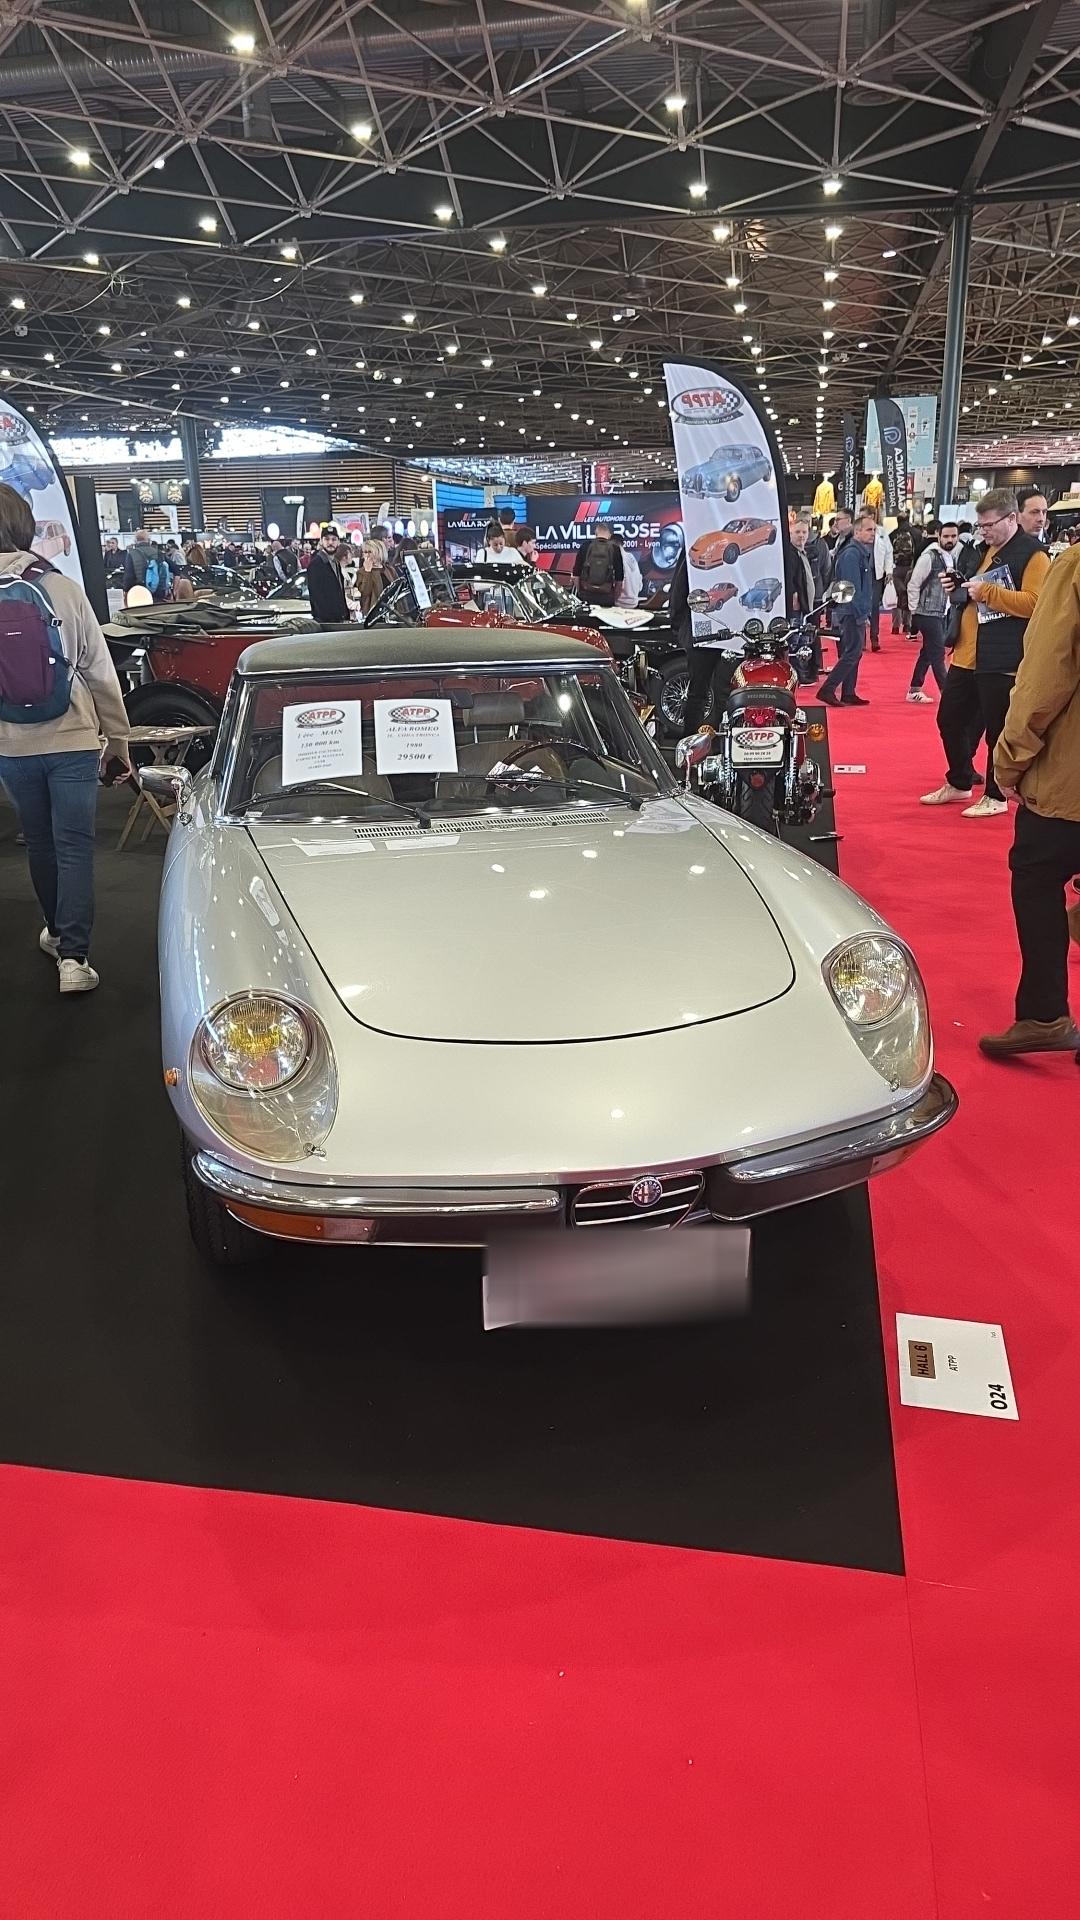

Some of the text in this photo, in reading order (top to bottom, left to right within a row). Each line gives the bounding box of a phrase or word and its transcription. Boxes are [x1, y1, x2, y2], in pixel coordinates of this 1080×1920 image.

[457, 519, 476, 528] VILLA
[535, 521, 661, 540] LA VILL ROSE
[535, 541, 571, 551] Spécialiste
[622, 540, 638, 548] 2001
[644, 540, 661, 548] Lyon
[308, 710, 337, 720] ATPP
[401, 708, 431, 717] ATPP
[746, 732, 775, 741] ATPP
[397, 753, 426, 761] 29500
[917, 1353, 929, 1376] HALL
[948, 1355, 958, 1372] ATPP
